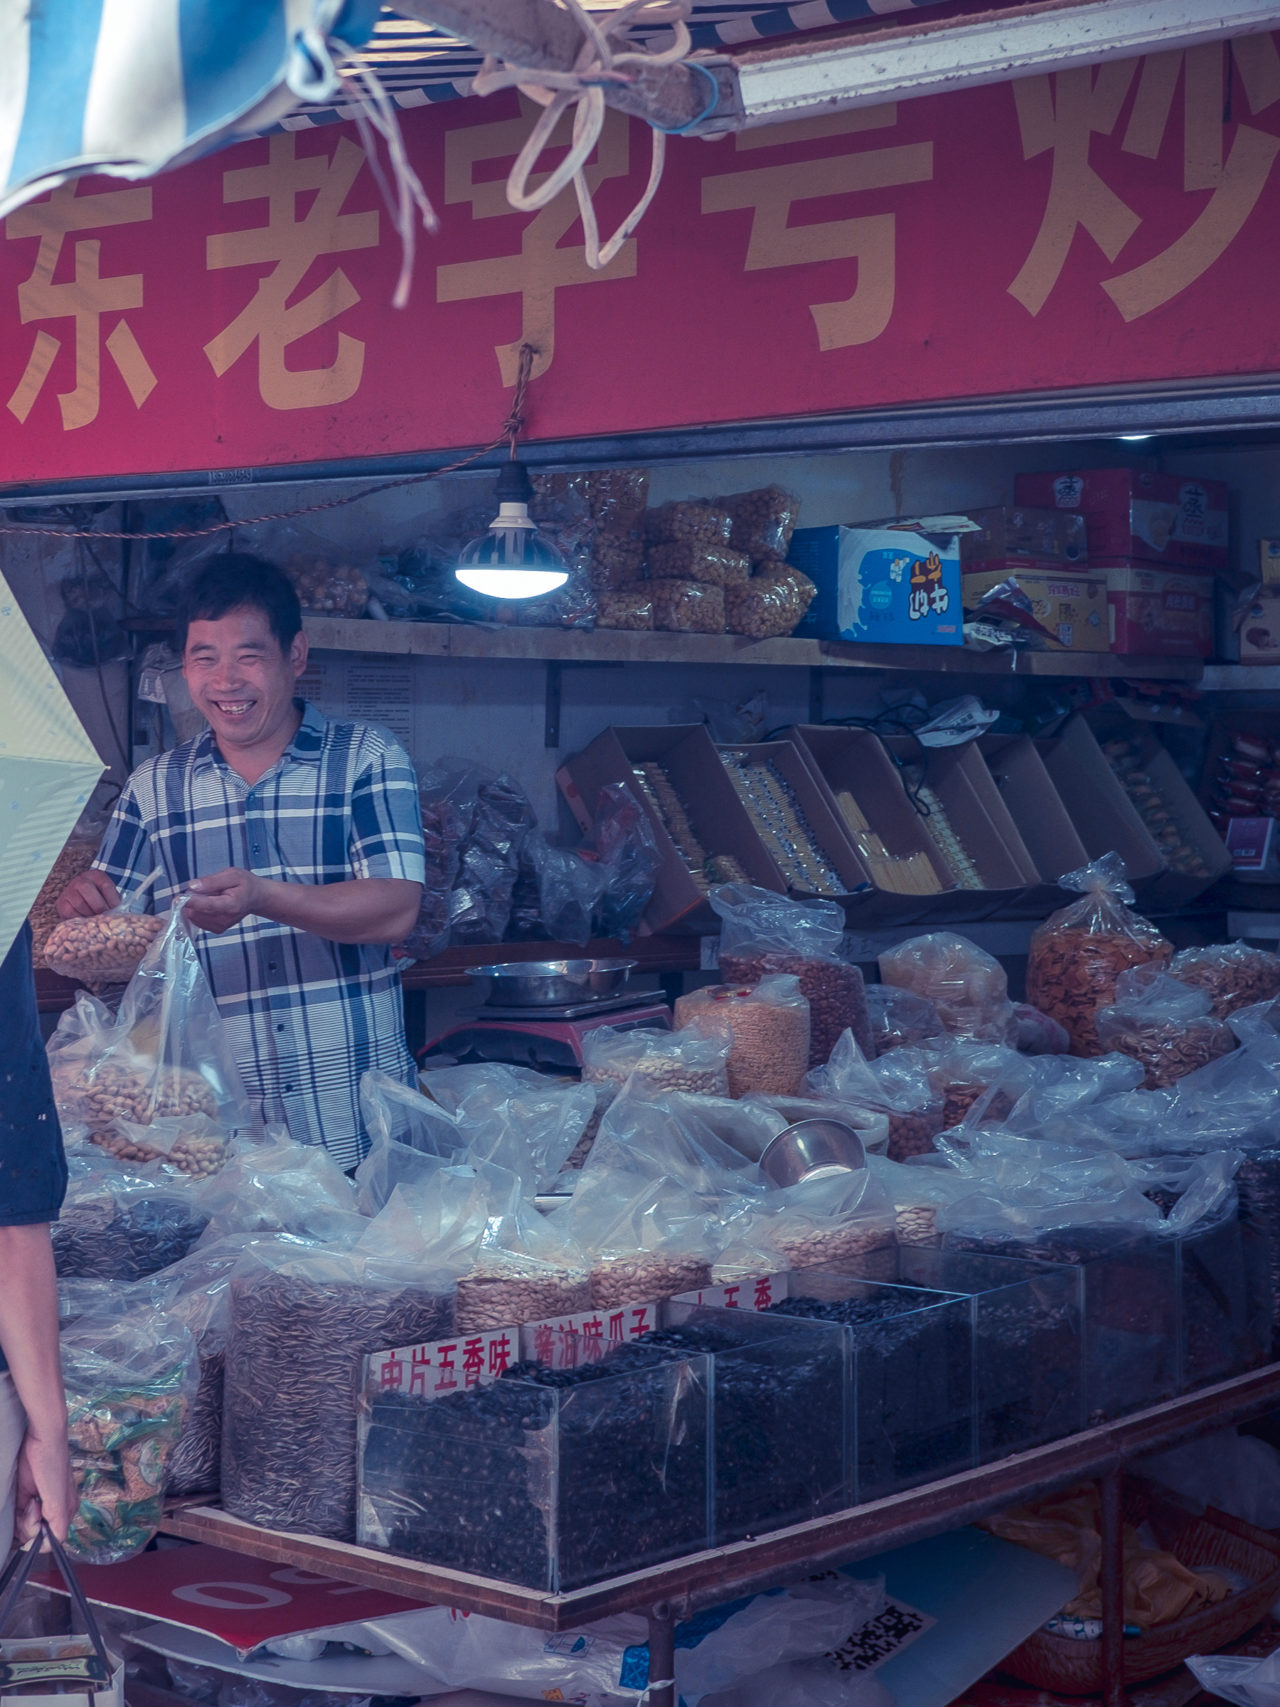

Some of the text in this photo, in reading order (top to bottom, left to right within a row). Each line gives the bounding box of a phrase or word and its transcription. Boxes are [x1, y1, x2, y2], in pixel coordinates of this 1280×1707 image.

[380, 1333, 511, 1396] 中片五香味
